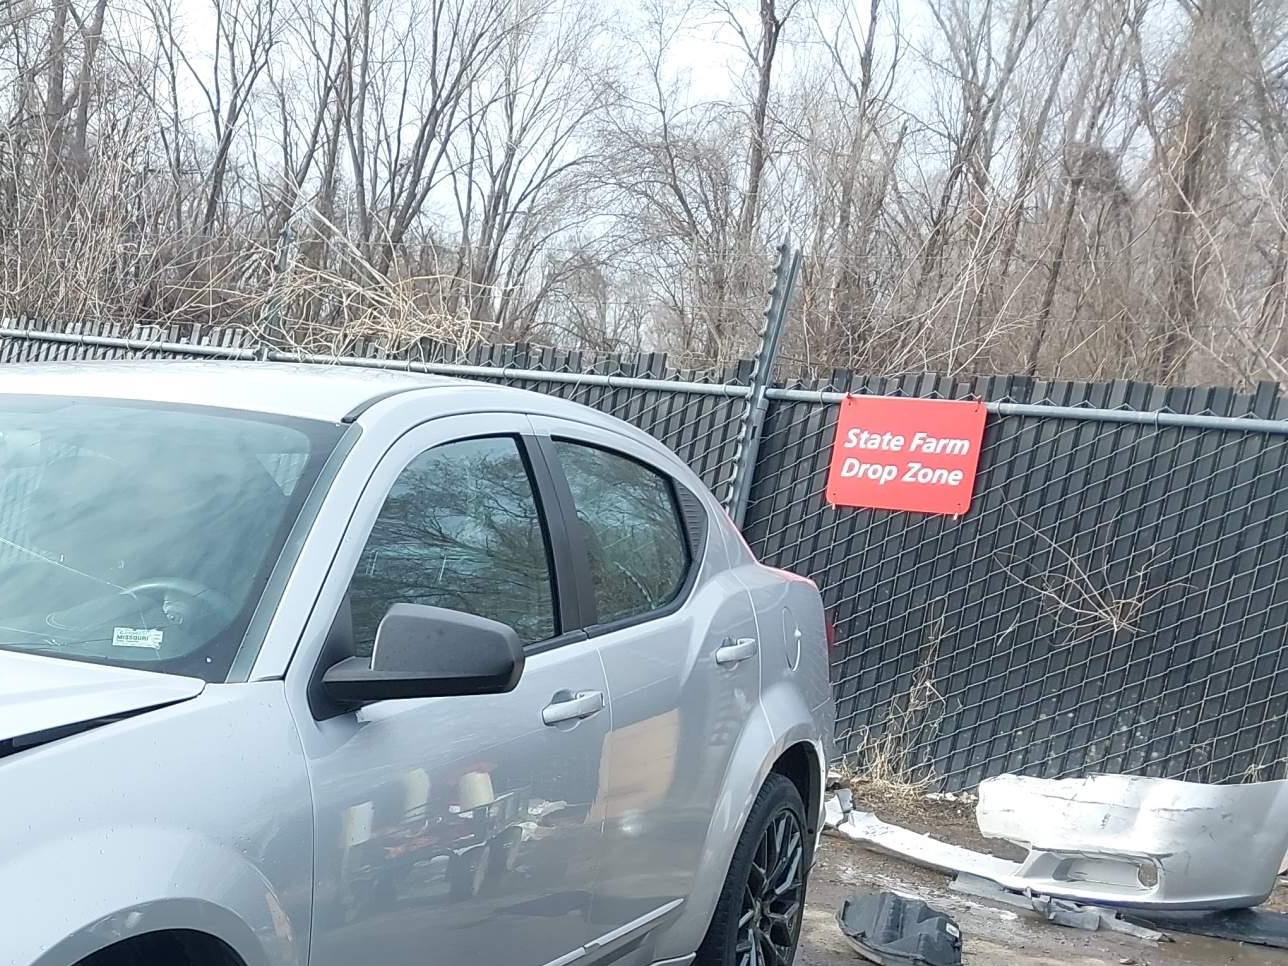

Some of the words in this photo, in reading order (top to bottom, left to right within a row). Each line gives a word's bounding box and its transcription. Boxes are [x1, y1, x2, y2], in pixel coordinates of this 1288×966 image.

[844, 428, 905, 453] State
[910, 432, 970, 456] Farm
[840, 458, 898, 485] Drop
[902, 463, 963, 486] Zone
